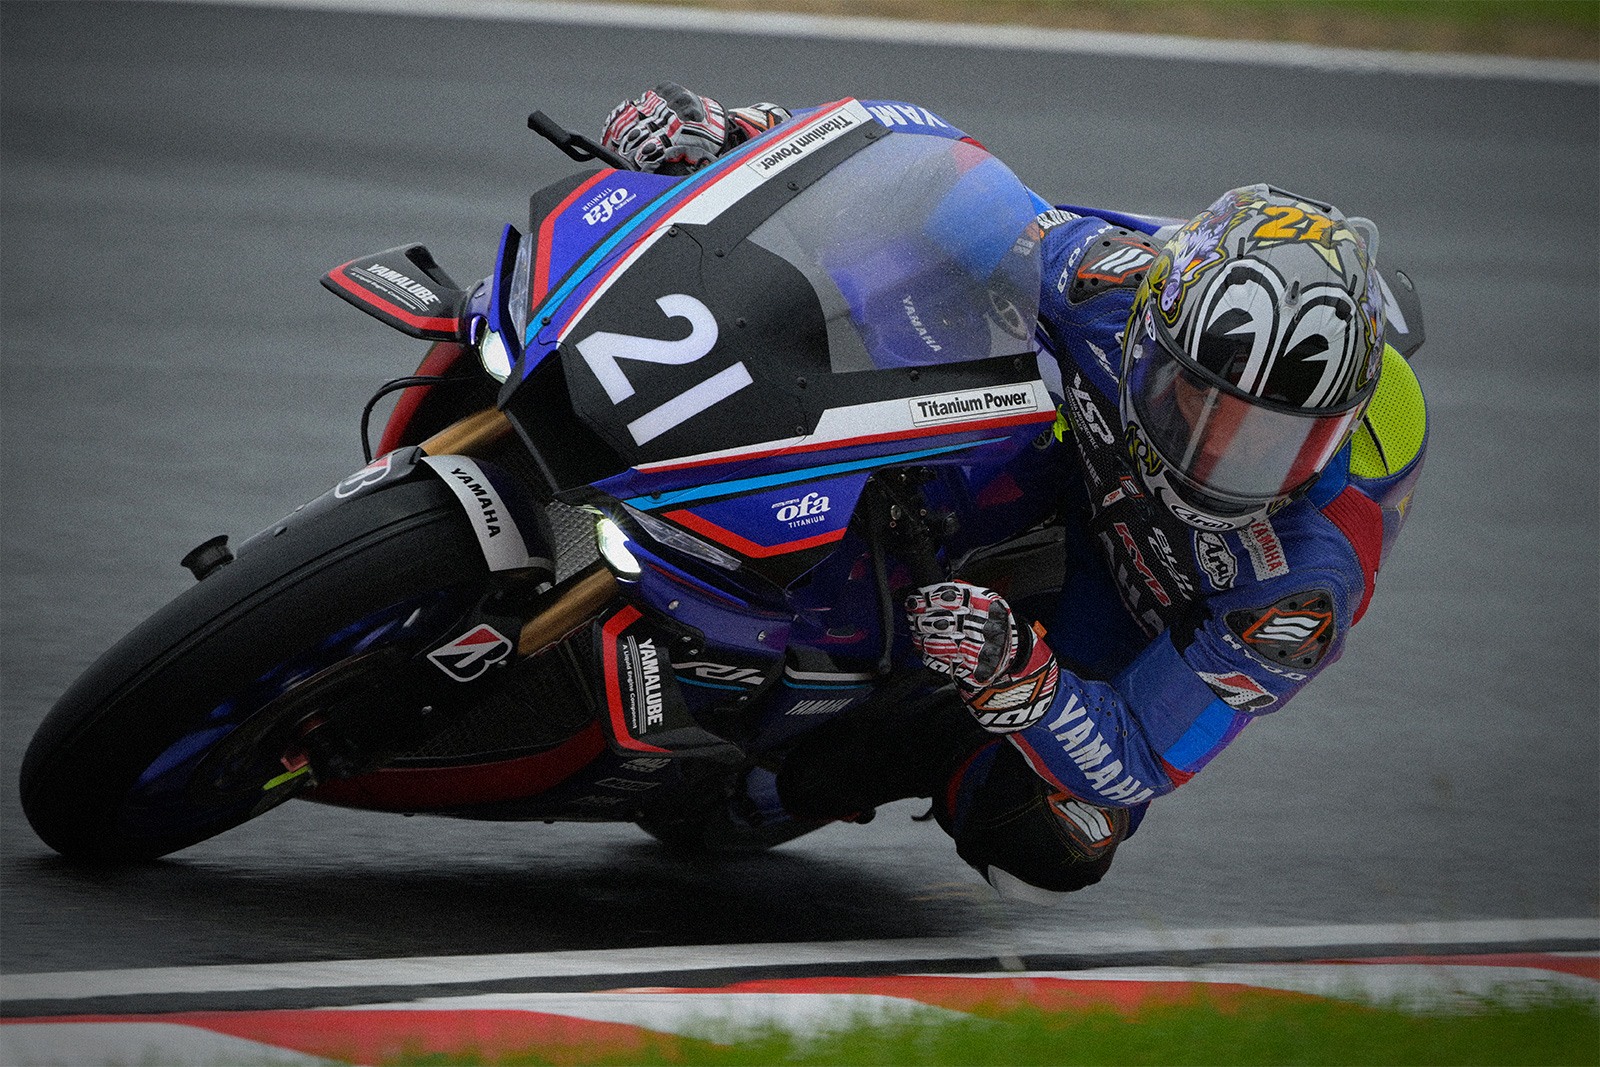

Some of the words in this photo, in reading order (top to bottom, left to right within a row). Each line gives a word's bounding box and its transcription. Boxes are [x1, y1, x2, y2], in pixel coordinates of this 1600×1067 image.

[795, 115, 853, 147] Titanium
[867, 105, 948, 128] YAM
[760, 143, 802, 170] Power
[582, 188, 628, 225] ofa
[366, 263, 441, 305] YAMALUBE
[902, 295, 943, 352] YAMAHA
[575, 293, 753, 447] 21
[917, 396, 983, 418] Titanium
[983, 391, 1027, 409] Power
[1071, 372, 1116, 445] YSP
[451, 468, 501, 538] YAMAHA
[776, 492, 831, 521] ofa
[788, 515, 825, 528] TITANIUM
[1113, 522, 1172, 607] KYB
[1199, 534, 1233, 582] Arai
[1250, 522, 1283, 572] YAMAHA
[1221, 633, 1307, 681] HYOD
[638, 638, 664, 727] YAMALUBE
[1047, 693, 1155, 806] YAMAHA
